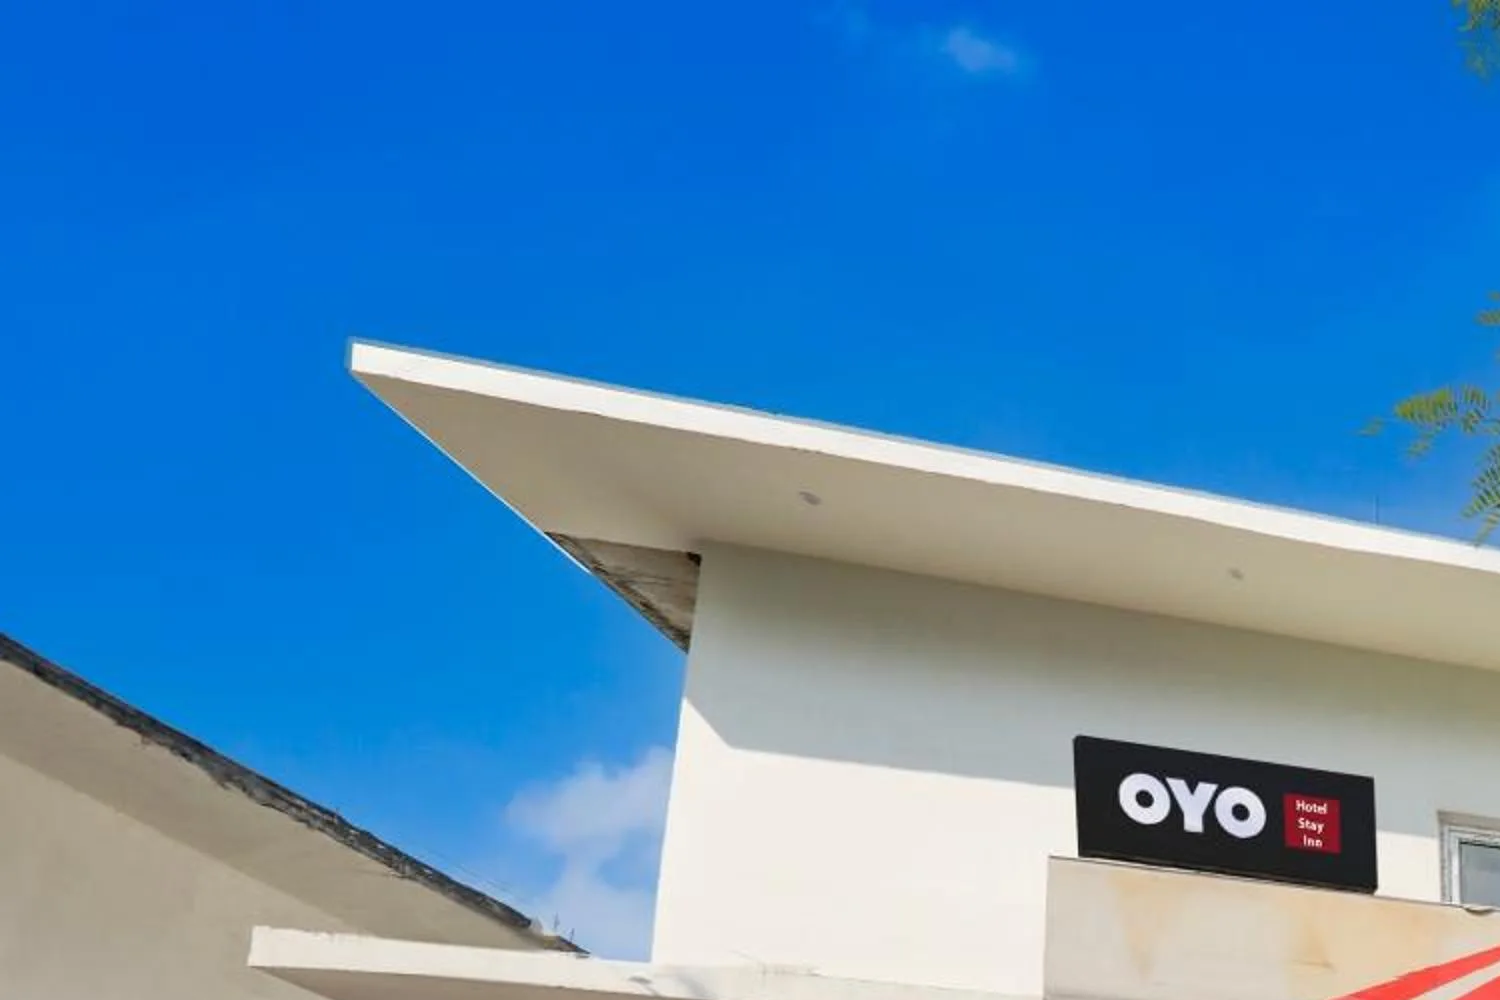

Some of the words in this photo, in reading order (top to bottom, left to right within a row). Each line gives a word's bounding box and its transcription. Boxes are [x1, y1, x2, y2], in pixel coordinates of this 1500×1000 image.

[1118, 772, 1267, 839] OYO
[1295, 799, 1328, 815] Hotel
[1297, 817, 1325, 835] Stay
[1302, 833, 1323, 848] Inn
